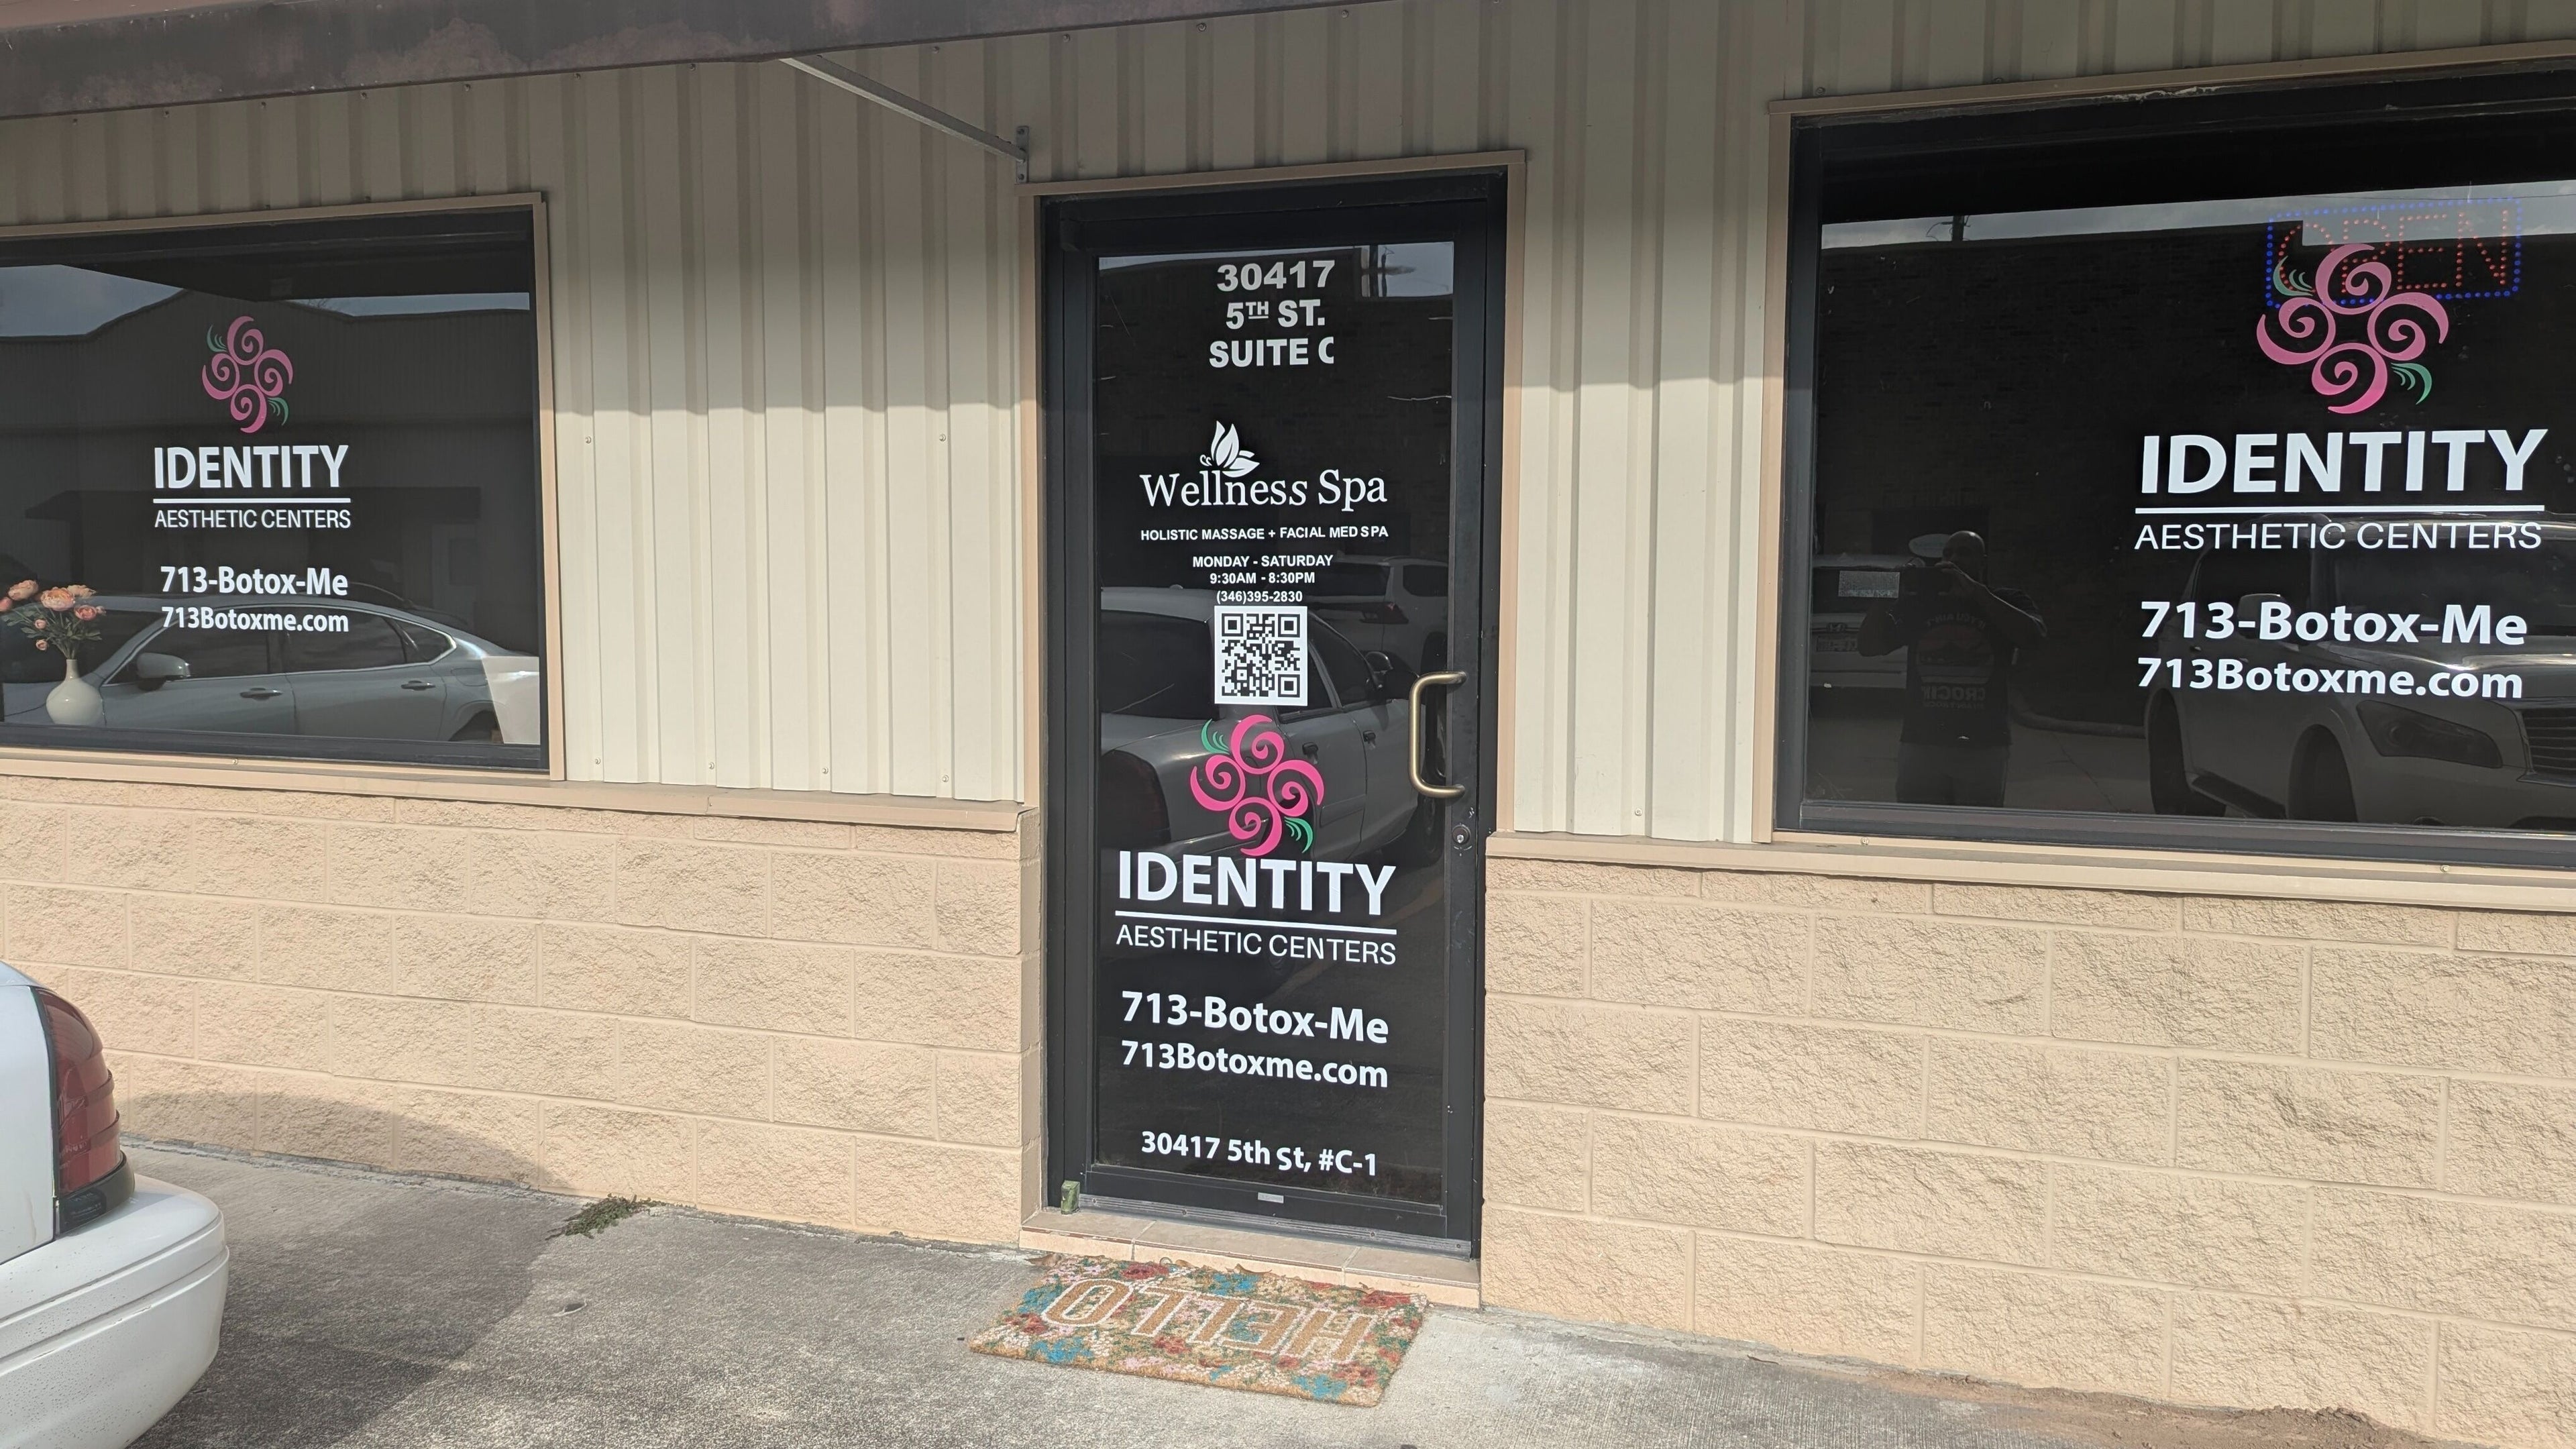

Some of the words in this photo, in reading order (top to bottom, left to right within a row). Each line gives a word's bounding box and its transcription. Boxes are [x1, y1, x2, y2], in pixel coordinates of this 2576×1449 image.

[2279, 207, 2509, 291] OPEN
[1217, 260, 1335, 292] 30417
[1226, 301, 1269, 329] 5TH
[1278, 299, 1326, 327] ST.
[1209, 337, 1309, 368] SUITE
[1318, 336, 1334, 364] C
[154, 445, 349, 489] IDENTITY
[2141, 429, 2548, 494] IDENTITY
[1139, 470, 1307, 507] Wellness
[1318, 469, 1388, 512] Spa
[154, 509, 258, 529] AESTHETIC
[261, 509, 351, 529] CENTERS
[1140, 529, 1198, 541] HOLISTIC
[1201, 528, 1265, 540] MASSAGE
[1268, 529, 1276, 538] +
[1280, 527, 1326, 539] FACIAL
[1329, 526, 1358, 538] MED
[2134, 524, 2347, 550] AESTHETIC
[2357, 522, 2542, 549] CENTERS
[160, 566, 349, 596] 713-Botox-Me
[1193, 555, 1250, 568] MONDAY
[1261, 554, 1334, 567] SATURDAY
[1210, 572, 1256, 585] 9:30AM
[1269, 572, 1315, 584] 8:30PM
[1216, 590, 1303, 604] (346)395-2830
[161, 606, 349, 632] 713Botoxme.com
[2141, 601, 2528, 645] 713-Botox-Me
[2138, 657, 2522, 698] 713Botoxme.com
[1119, 850, 1397, 916] IDENTITY
[1116, 924, 1262, 955] AESTHETIC
[1269, 934, 1396, 965] CENTERS
[1122, 990, 1389, 1044] 713-Botox-Me
[1122, 1040, 1388, 1088] 713Botoxme.com
[1141, 1130, 1220, 1159] 30417
[1227, 1139, 1271, 1165] 5th
[1276, 1146, 1311, 1173] St,
[1318, 1148, 1375, 1176] #C-1
[1040, 1277, 1379, 1364] HELLO
